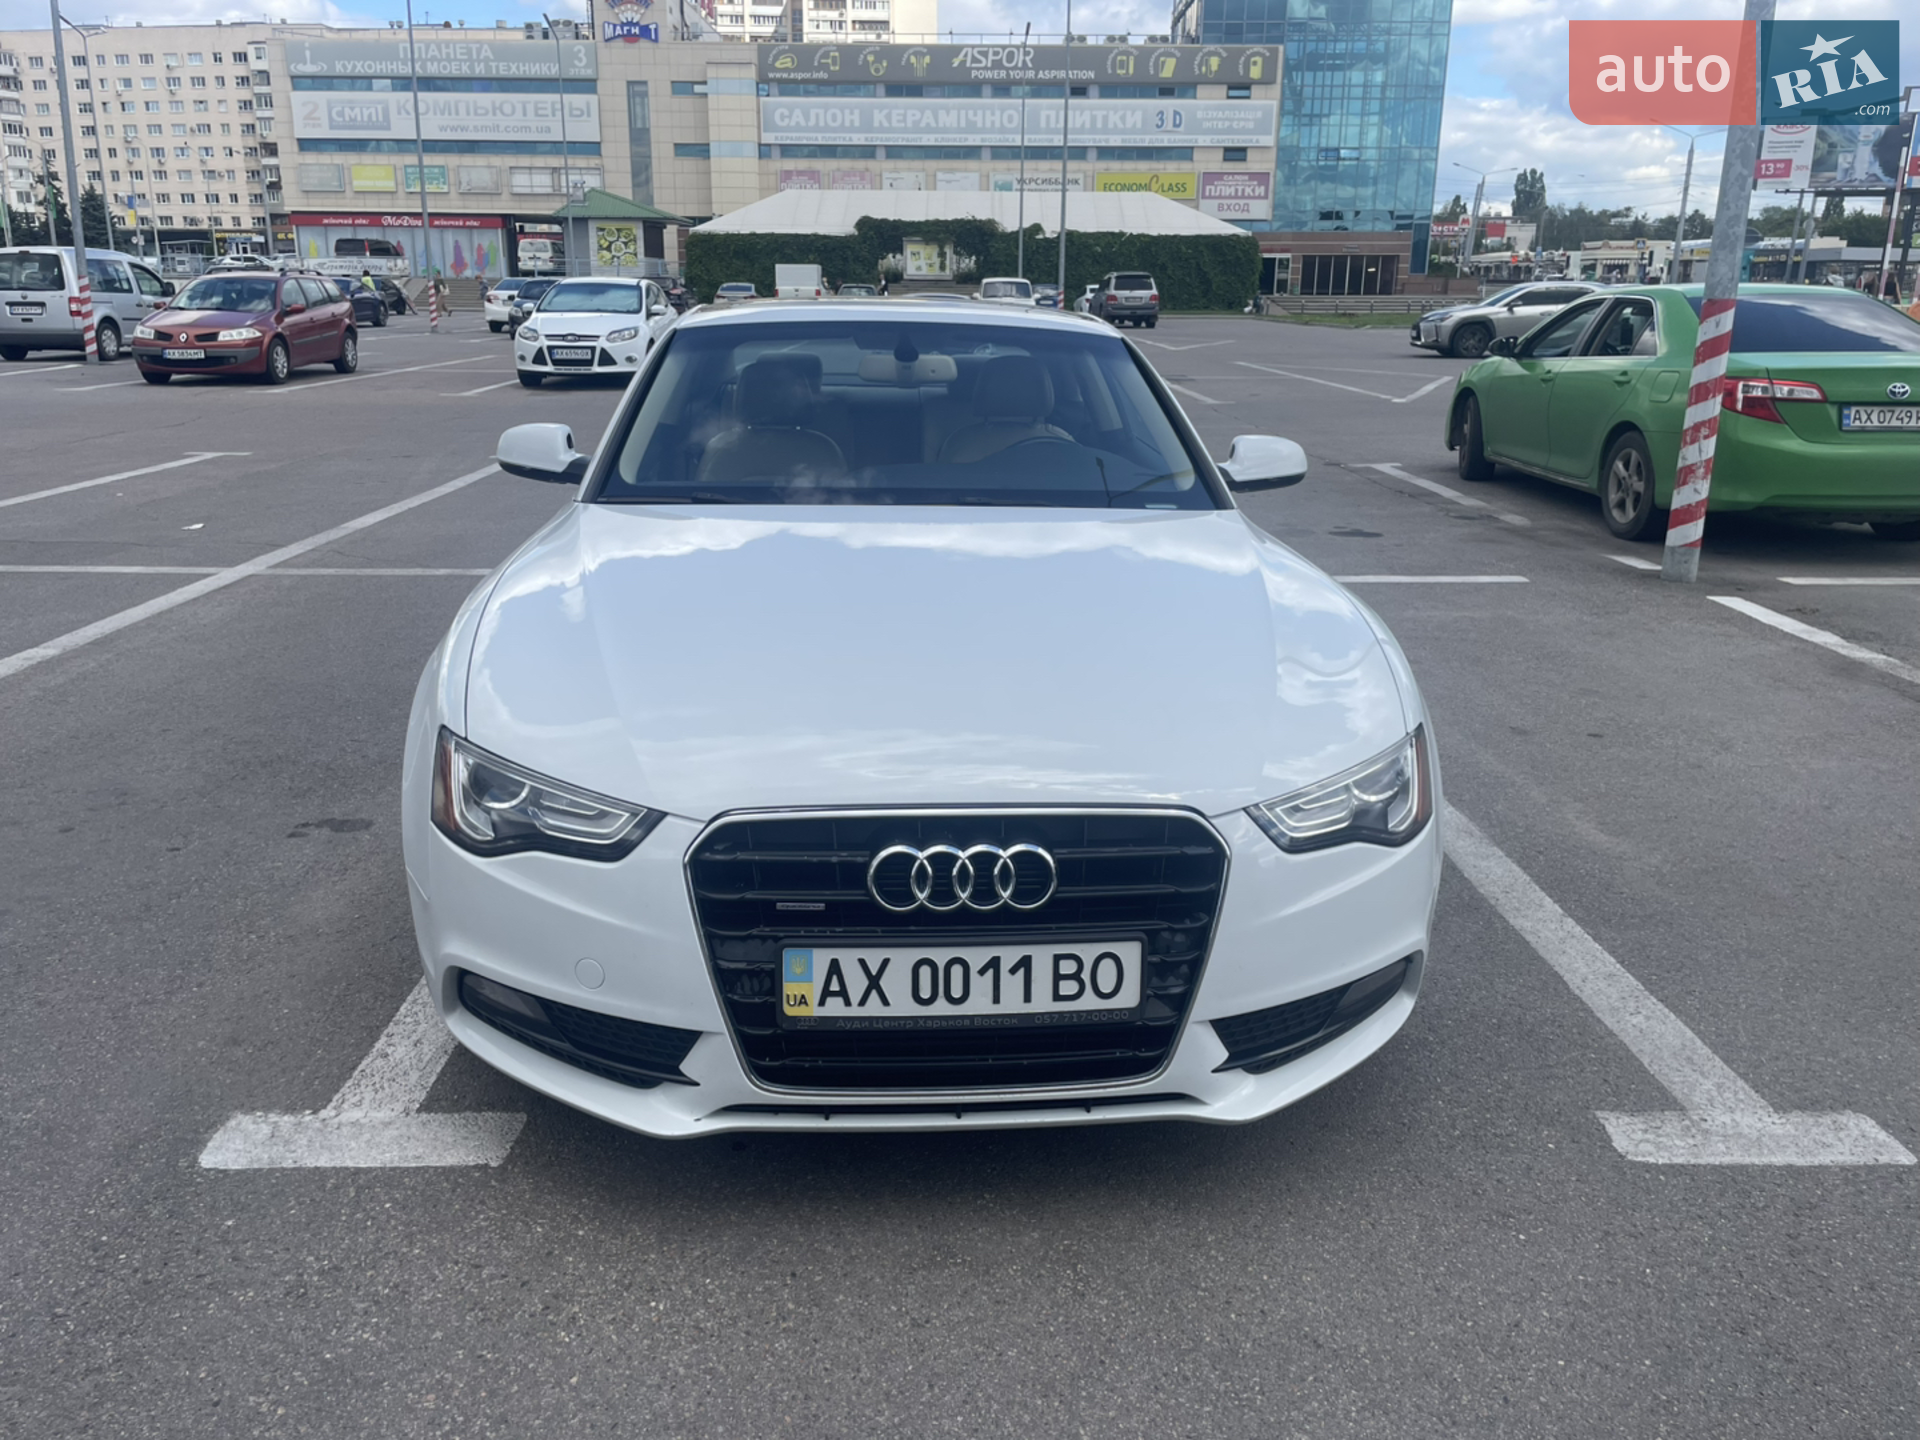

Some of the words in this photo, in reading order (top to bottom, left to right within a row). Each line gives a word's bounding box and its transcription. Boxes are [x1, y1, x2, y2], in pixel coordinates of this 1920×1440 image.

[398, 43, 494, 60] ПЛАНЕТА
[574, 45, 588, 67] 3
[952, 47, 1034, 68] ASPOR
[335, 60, 422, 74] КУХОННЫХ
[426, 62, 470, 74] МОЕК
[475, 62, 485, 75] И
[489, 62, 560, 76] ТЕХНИКИ
[768, 70, 828, 80] www.aspor.info
[972, 70, 1006, 79] POWER
[1009, 70, 1035, 79] YOUR
[1037, 70, 1095, 79] ASPIRATION
[301, 101, 321, 121] 2
[396, 100, 592, 118] КОМПЬЮТЕРЫ
[774, 108, 860, 127] САЛОН
[1040, 110, 1142, 128] ПЛИТКИ
[438, 122, 552, 134] www.smit.com.ua
[1760, 164, 1774, 176] 13
[1015, 177, 1080, 186] УКРСИББНК
[1205, 186, 1265, 196] ПЛИТКИ
[1218, 202, 1250, 213] ВХОД
[818, 957, 891, 1007] AX
[911, 954, 1032, 1006] 0011
[1052, 952, 1124, 1002] BO
[786, 994, 809, 1007] UA
[836, 1018, 869, 1030] Ауди
[873, 1018, 914, 1030] Центр
[916, 1018, 970, 1028] Харьков
[974, 1016, 1018, 1026] Восток
[1034, 1014, 1058, 1024] 057
[1063, 1010, 1128, 1022] 717-00-00
